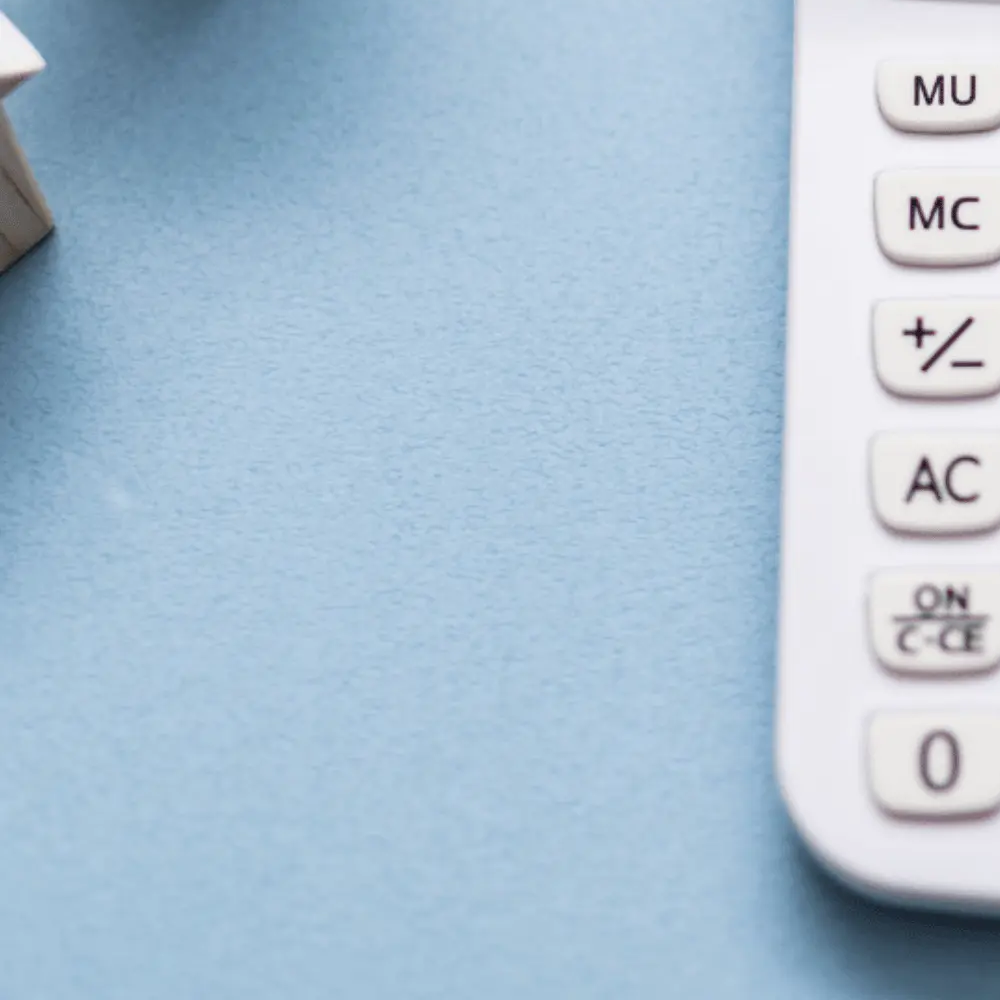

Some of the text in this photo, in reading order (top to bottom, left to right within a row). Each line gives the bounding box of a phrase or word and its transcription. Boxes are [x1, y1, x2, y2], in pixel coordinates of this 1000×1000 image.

[914, 75, 976, 106] MU
[909, 196, 980, 231] MC
[906, 455, 979, 504] AC
[913, 582, 972, 613] ON
[919, 731, 961, 792] 0
